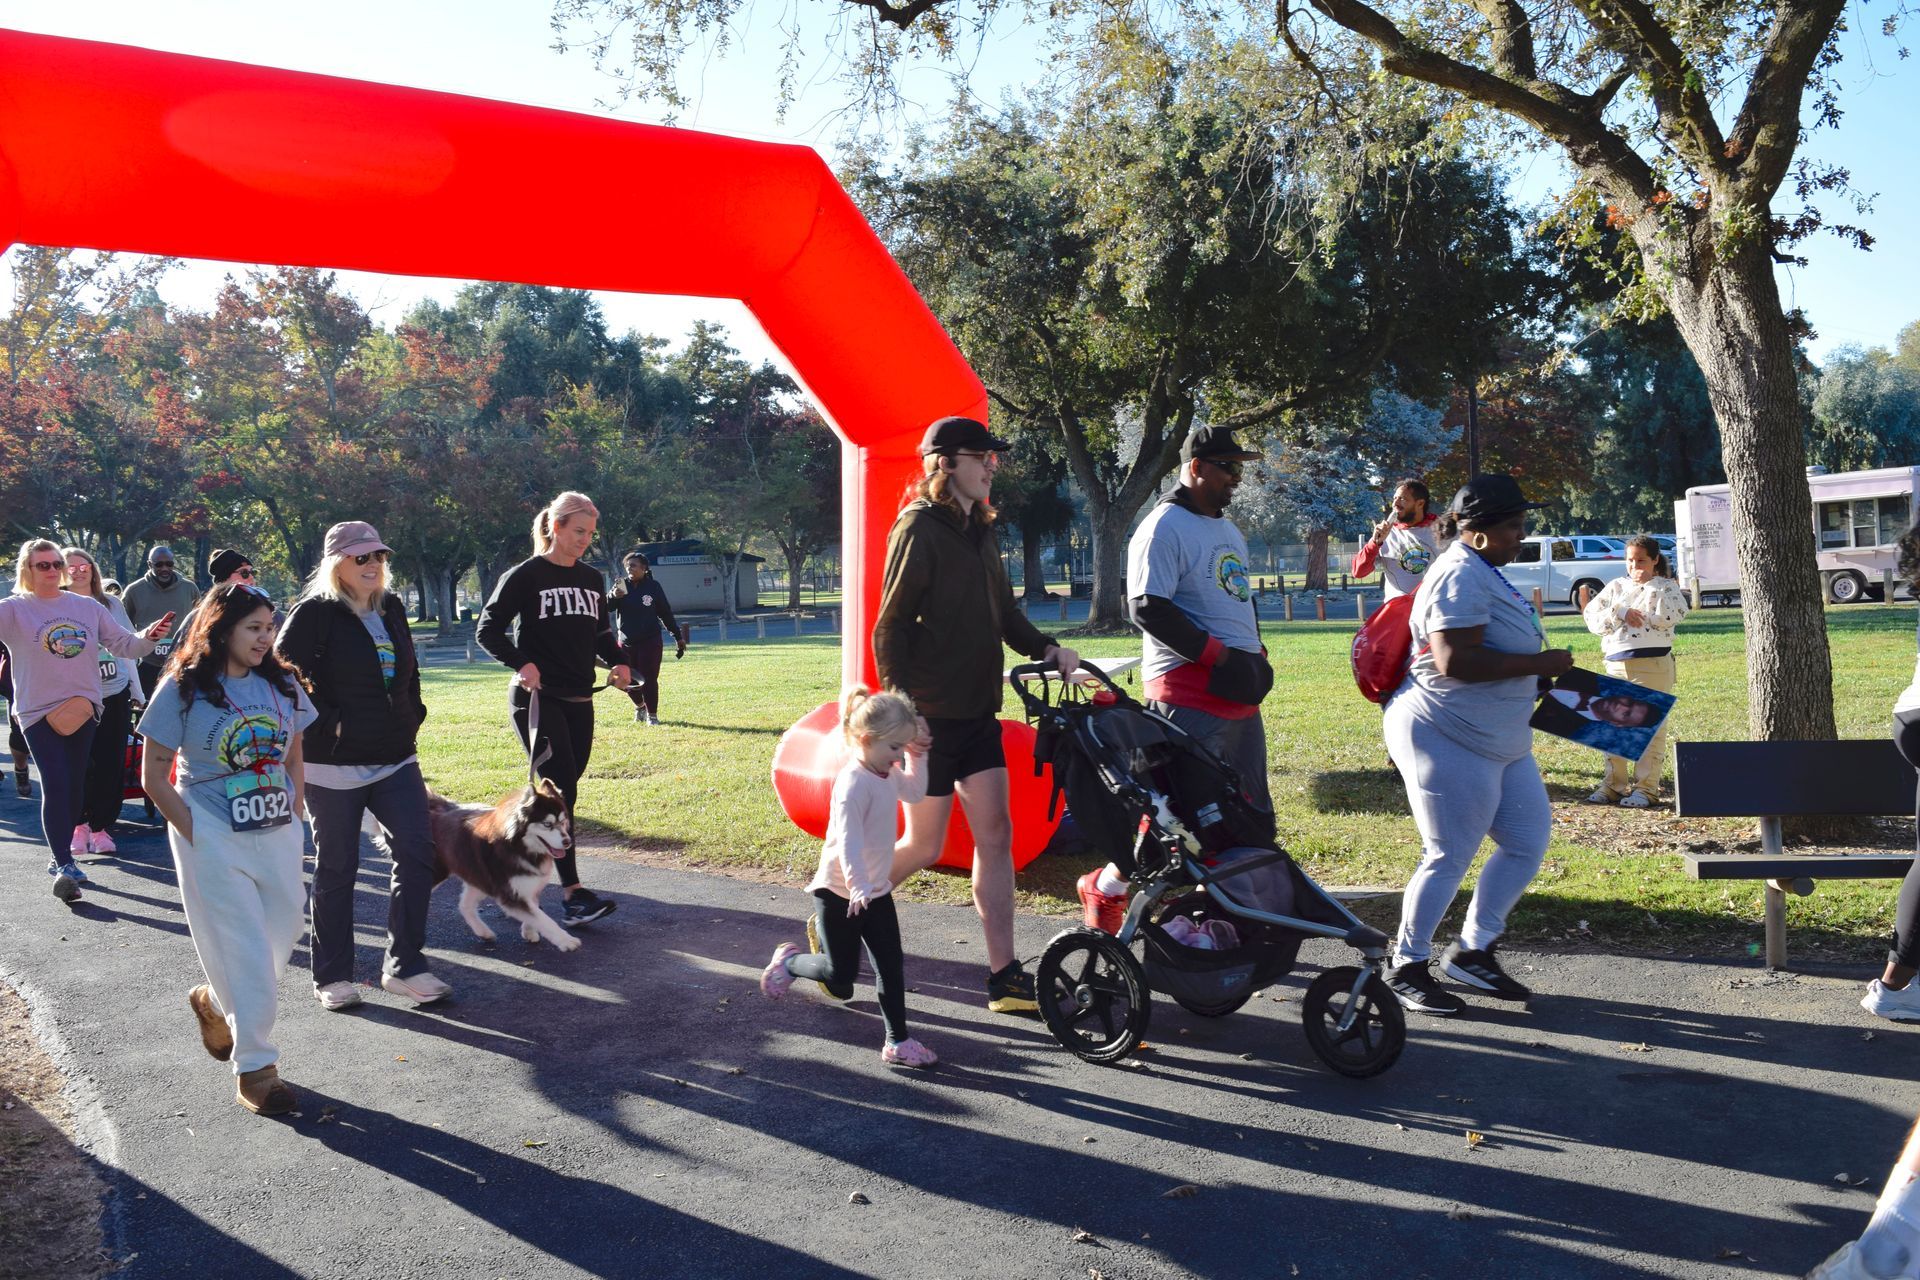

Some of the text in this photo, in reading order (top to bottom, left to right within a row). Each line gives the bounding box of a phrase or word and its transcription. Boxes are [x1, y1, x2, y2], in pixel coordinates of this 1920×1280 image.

[98, 662, 117, 678] 10
[203, 715, 228, 752] Lamont
[232, 791, 291, 824] 6032
